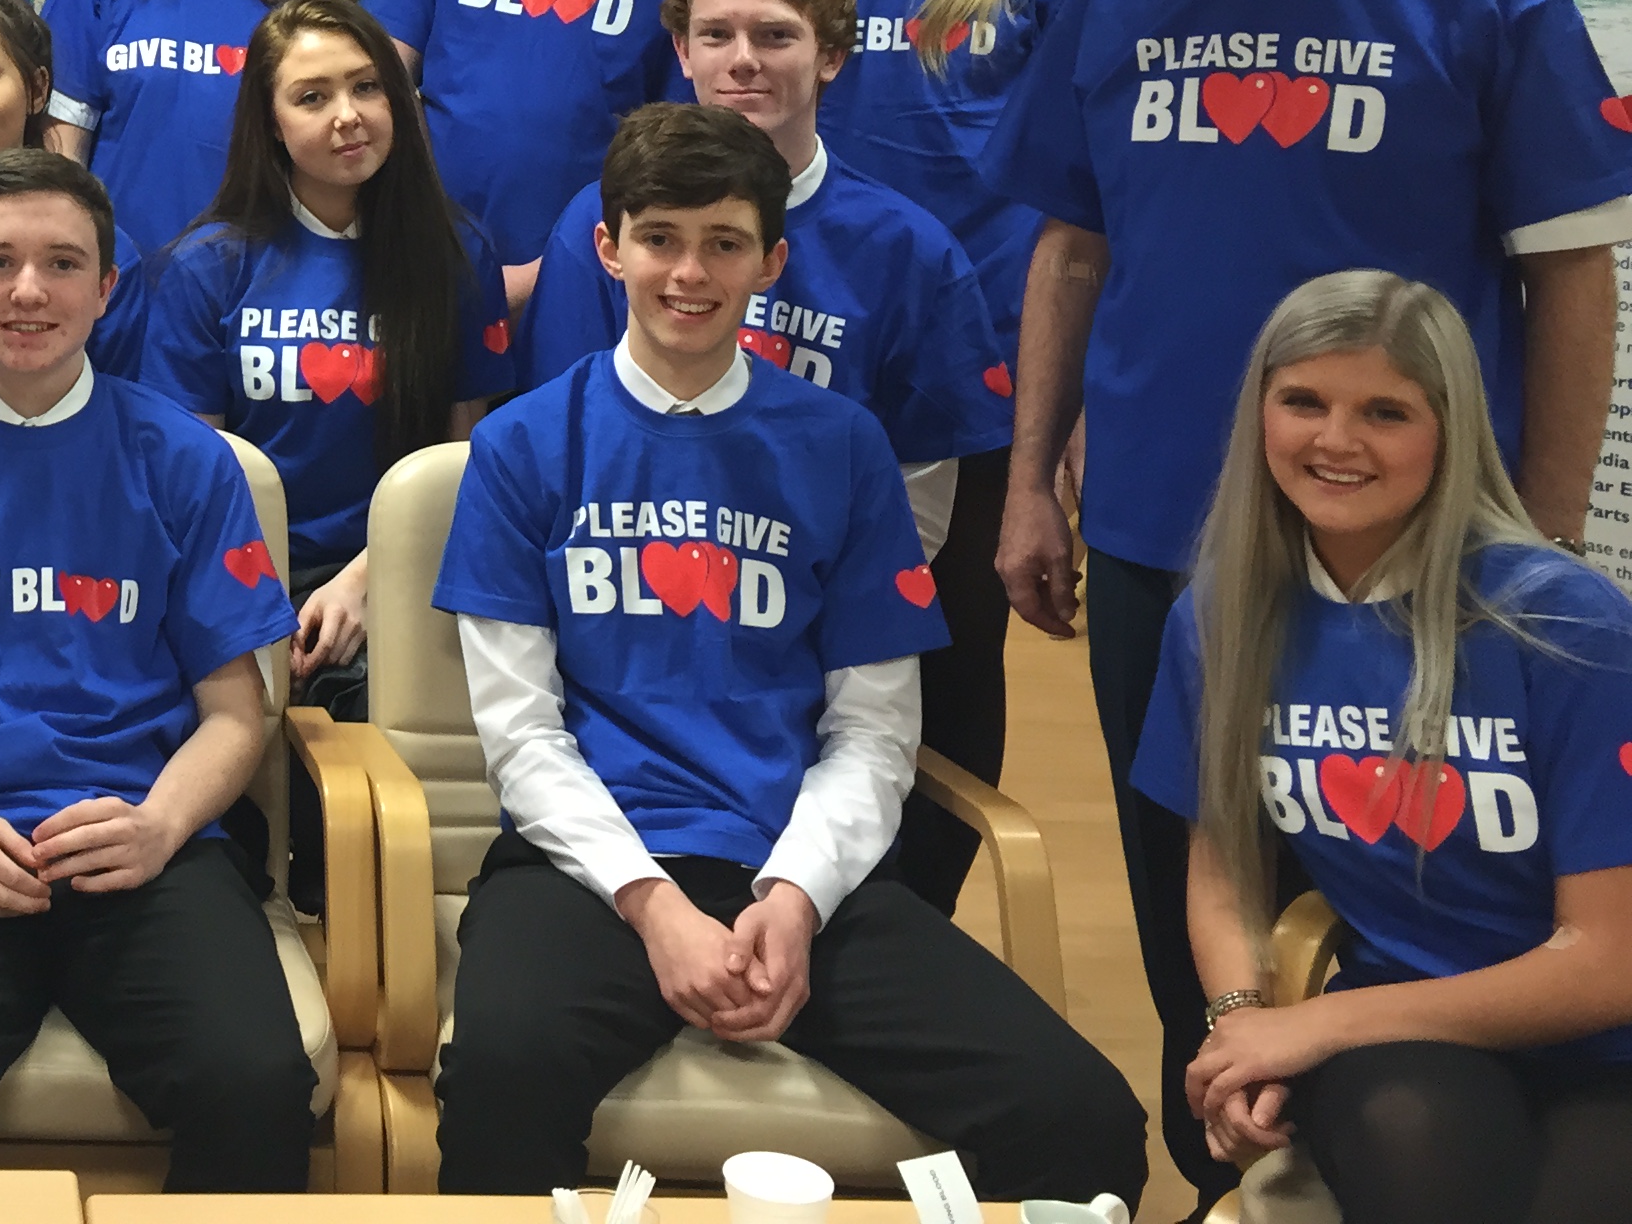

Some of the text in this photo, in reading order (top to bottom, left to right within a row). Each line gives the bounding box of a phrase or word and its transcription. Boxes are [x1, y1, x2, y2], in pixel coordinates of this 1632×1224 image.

[106, 38, 178, 72] GIVE
[1136, 32, 1396, 78] PLEASE GIVE
[240, 307, 358, 341] PLEASE
[770, 300, 846, 349] GIVE
[570, 499, 792, 557] PLEASE GIVE
